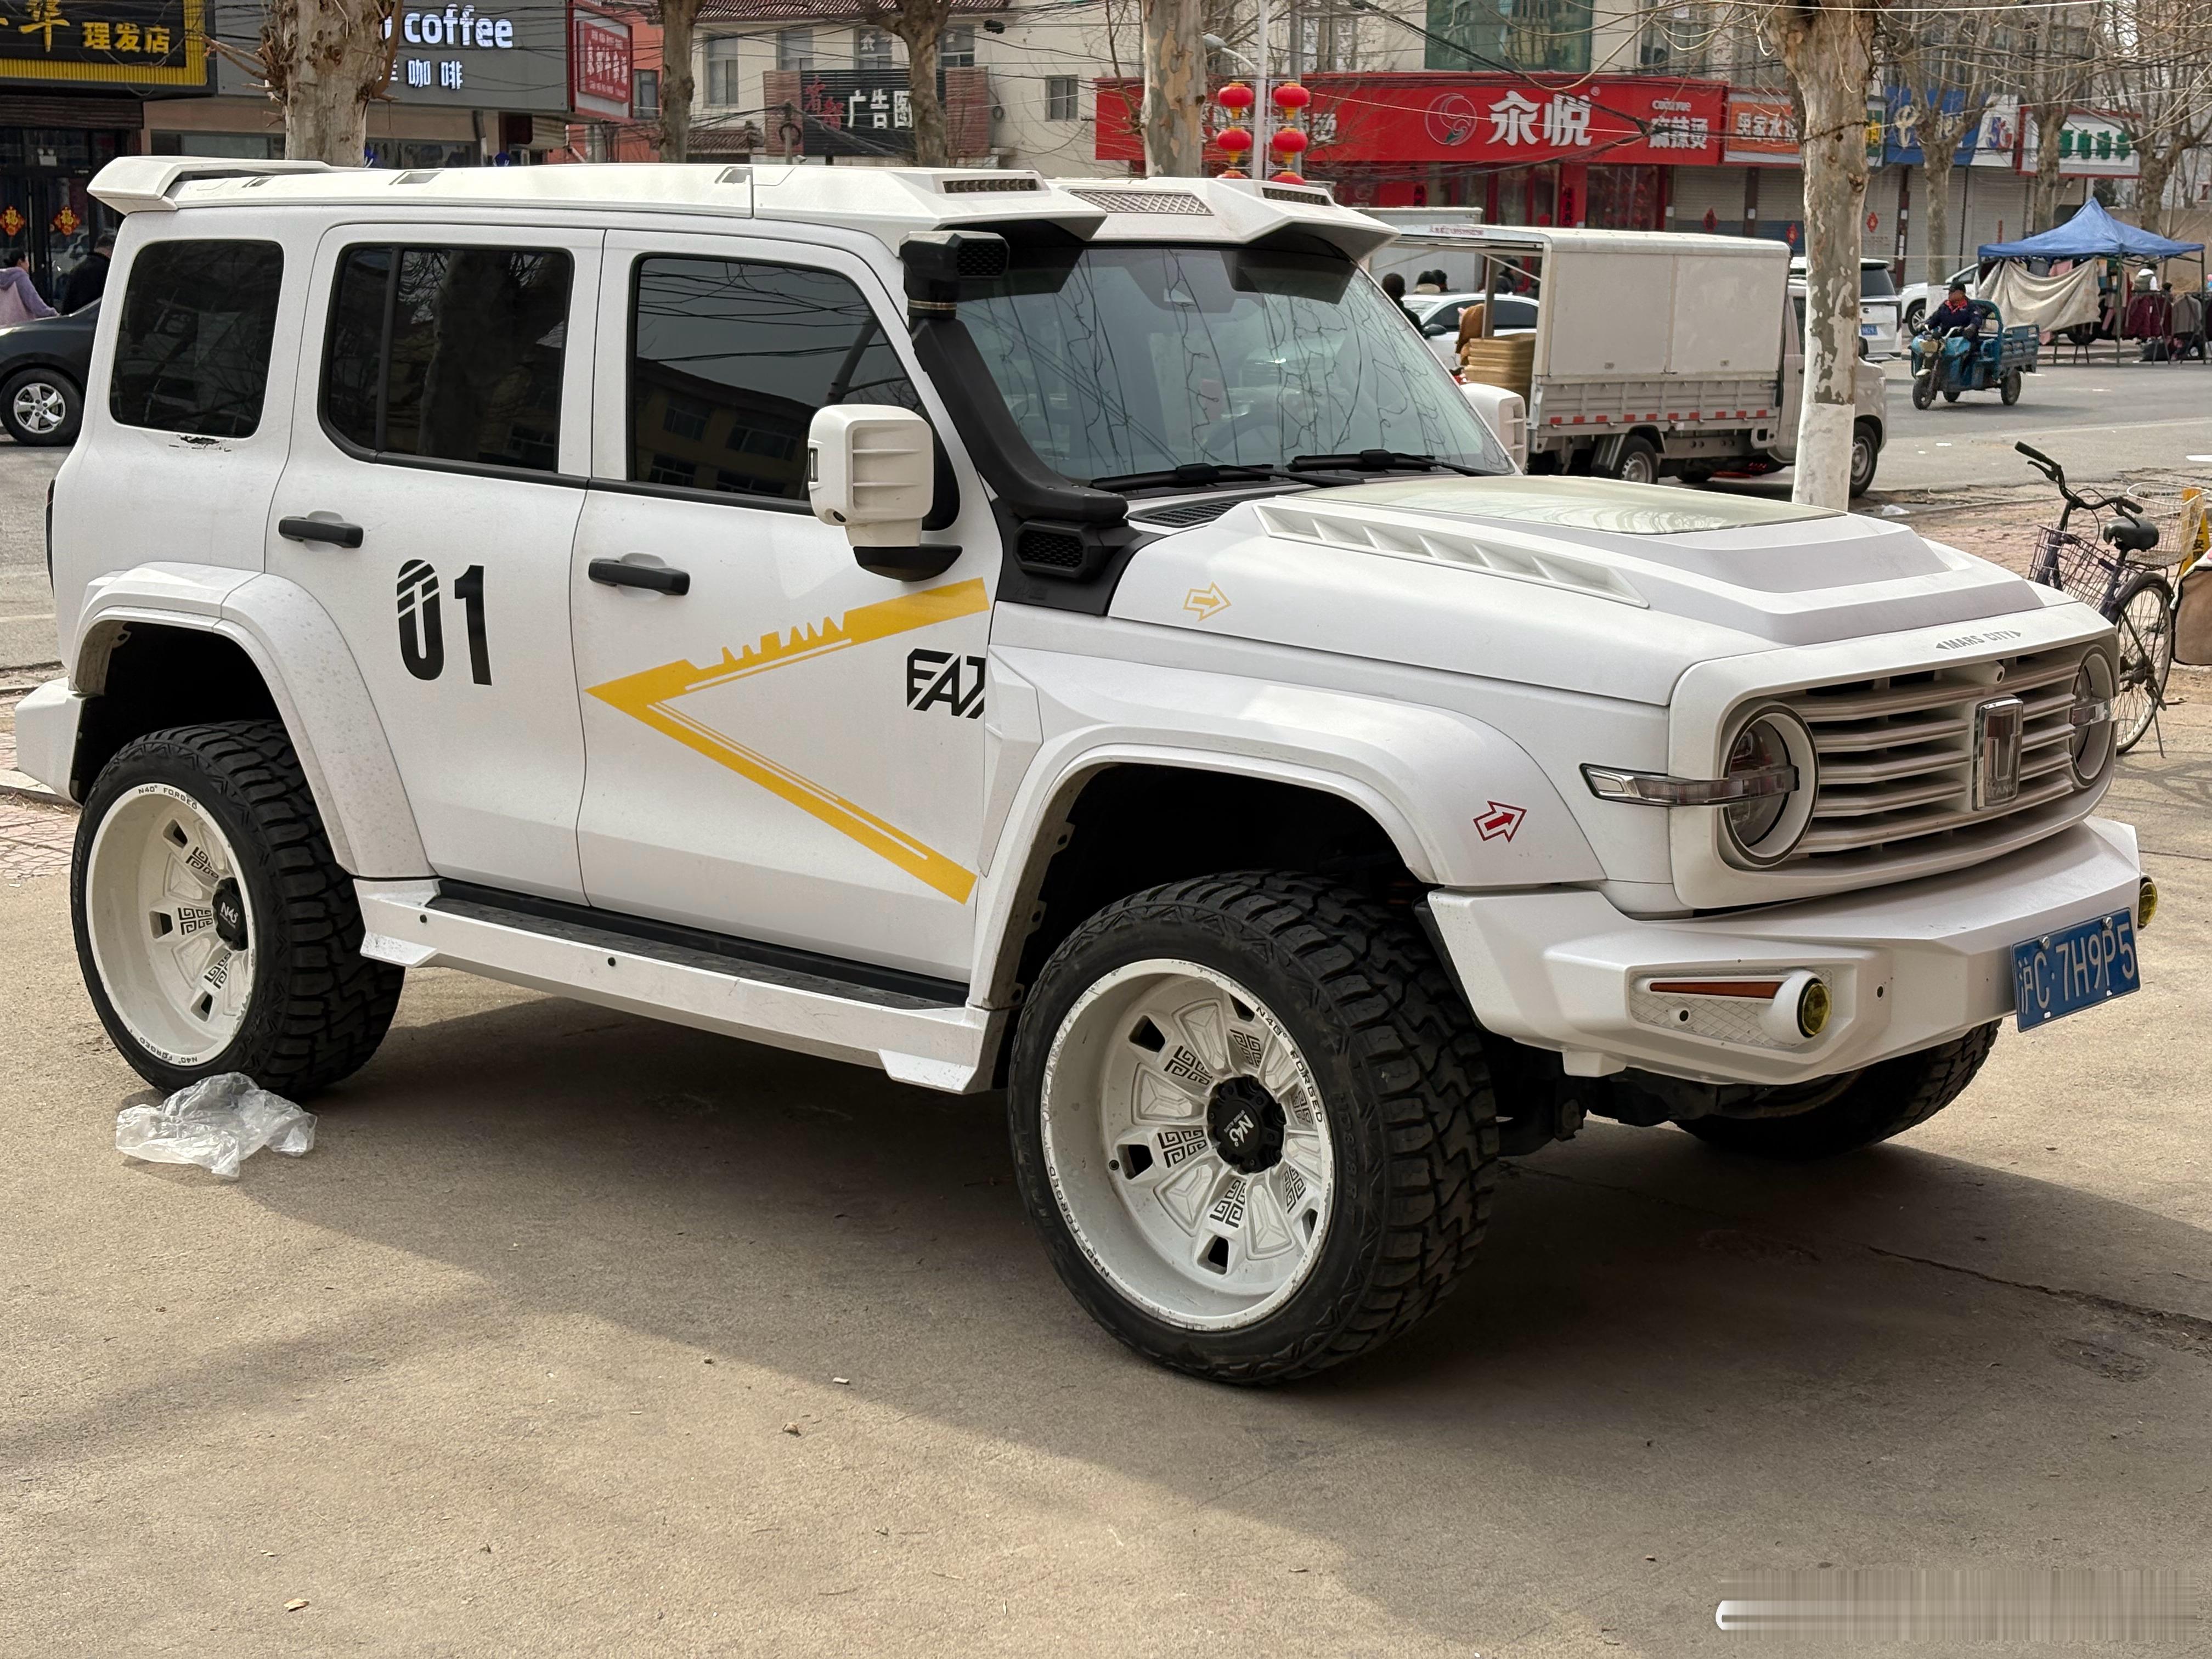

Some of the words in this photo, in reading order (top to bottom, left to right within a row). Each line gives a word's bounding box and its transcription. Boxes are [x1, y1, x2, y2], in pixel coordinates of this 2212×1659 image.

[82, 22, 170, 54] 理发店
[404, 3, 513, 48] coffee
[1987, 116, 2013, 149] 5G
[396, 558, 493, 686] 01
[1942, 635, 1985, 650] MARS
[1984, 630, 2015, 641] CITY
[163, 787, 198, 810] FORGED
[139, 1036, 173, 1062] FORGED
[1290, 1049, 1323, 1122] FORGED
[1049, 1166, 1081, 1234] FORGED
